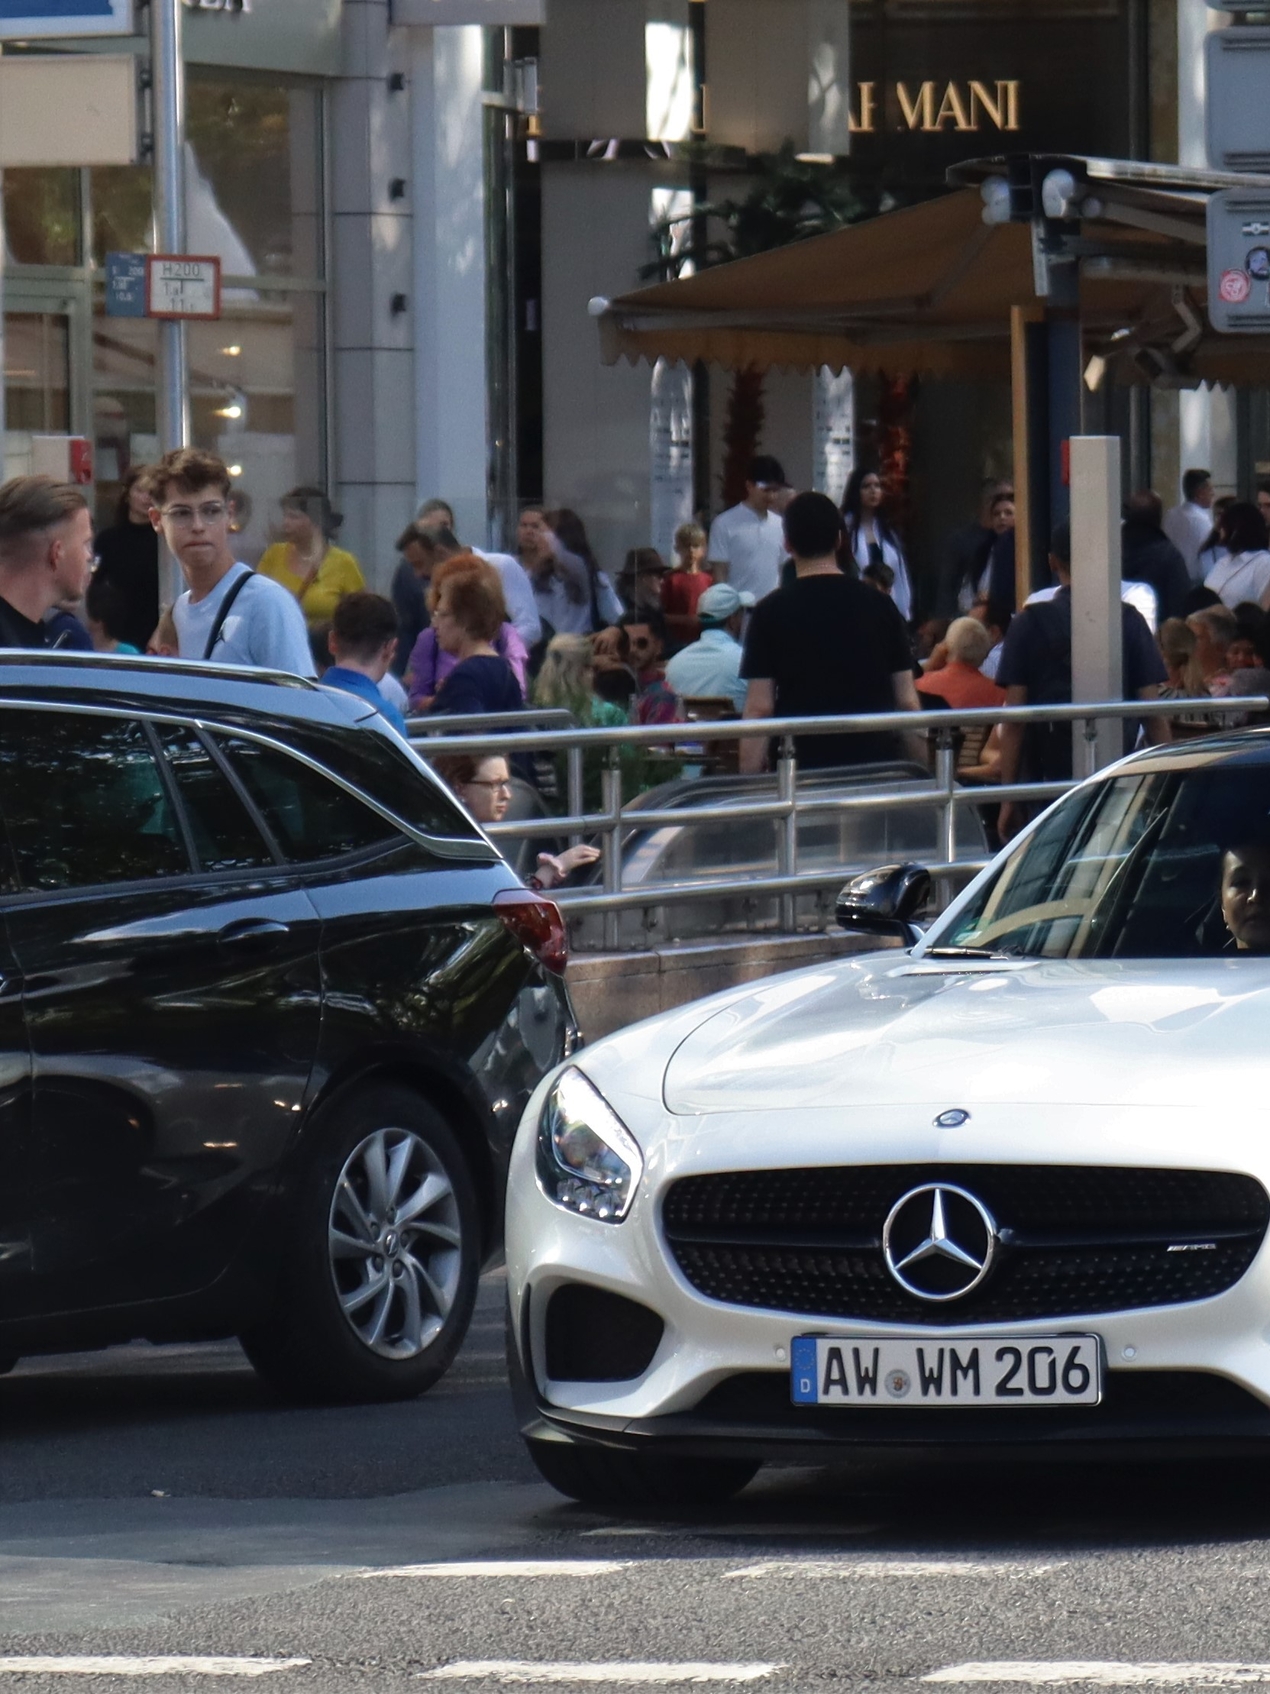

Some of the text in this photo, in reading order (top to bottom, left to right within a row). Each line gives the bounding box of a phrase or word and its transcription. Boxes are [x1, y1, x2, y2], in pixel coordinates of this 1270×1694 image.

[800, 1378, 811, 1393] D
[822, 1345, 1091, 1397] AW WM 206
